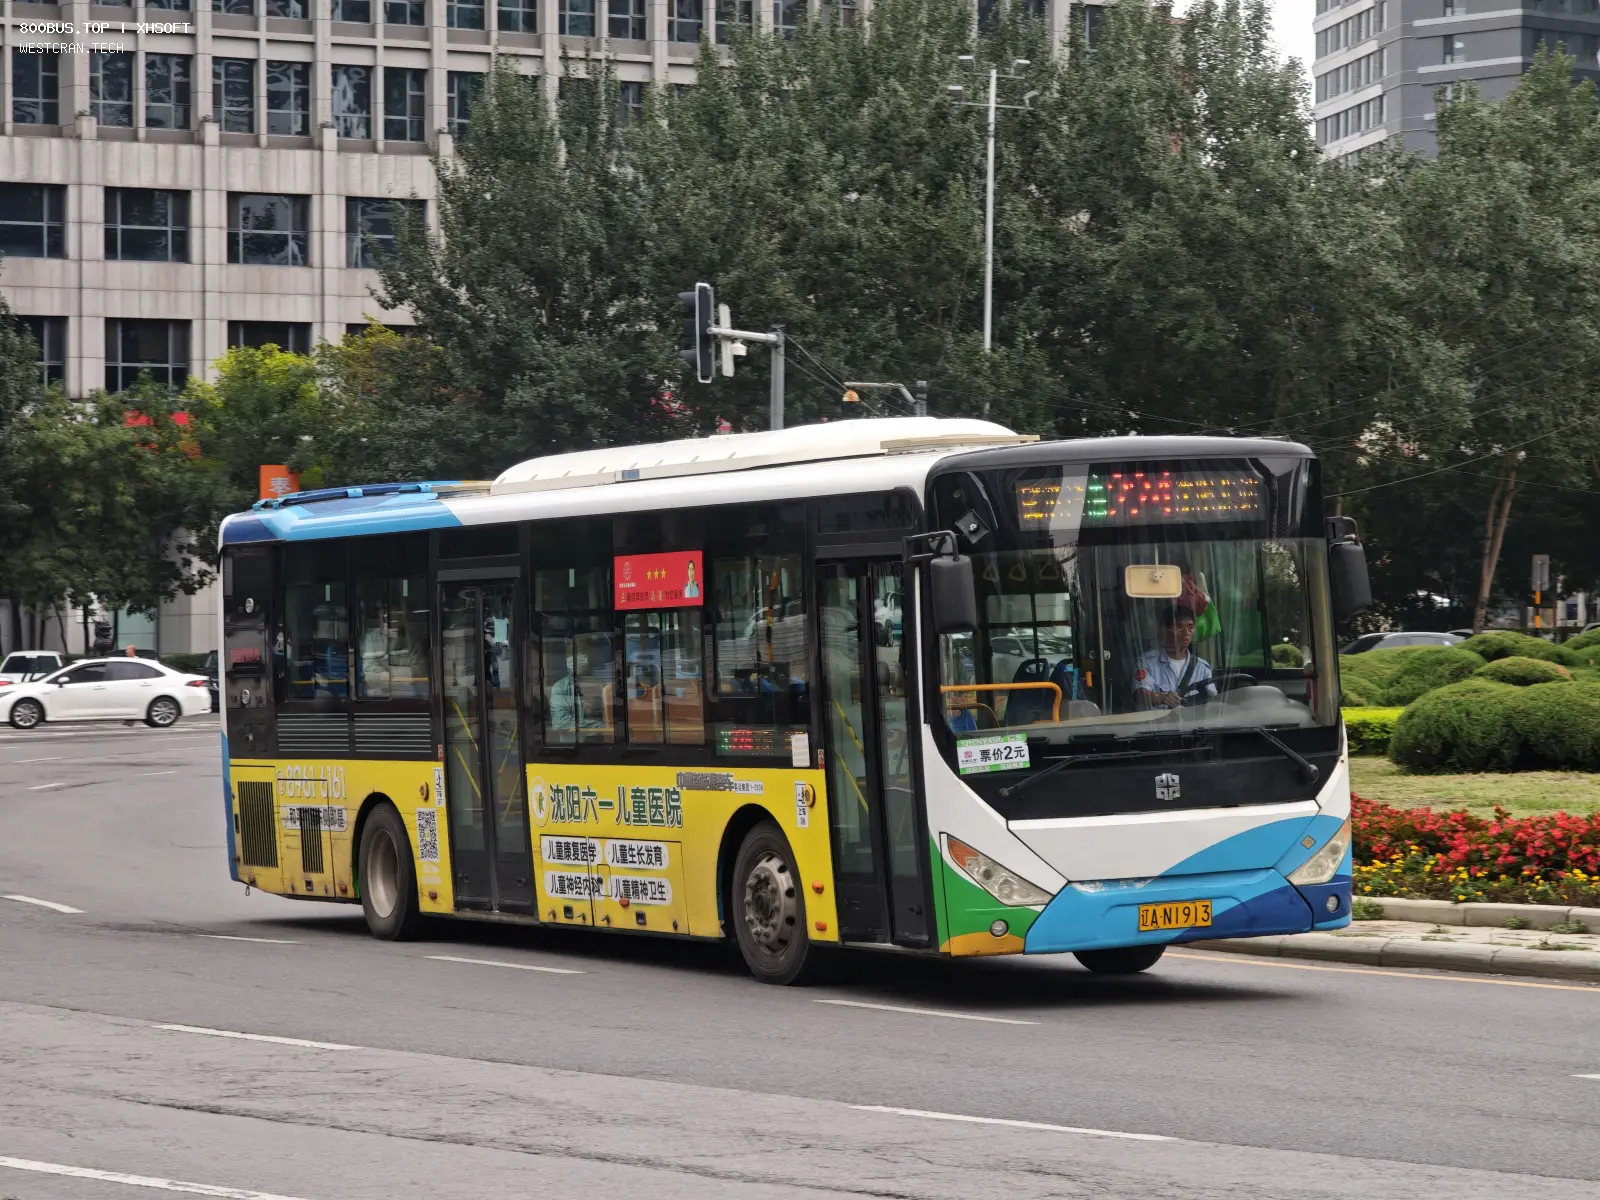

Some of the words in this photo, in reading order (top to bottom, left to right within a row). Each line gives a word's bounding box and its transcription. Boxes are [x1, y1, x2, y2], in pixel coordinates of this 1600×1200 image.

[979, 746, 1026, 762] 票价2元
[549, 784, 683, 828] 沈阳六一儿童医院
[547, 840, 597, 862] 儿童康复医学
[611, 843, 663, 866] 儿童生长发育
[550, 875, 602, 898] 儿童神经内科
[614, 878, 667, 901] 儿童精神卫生
